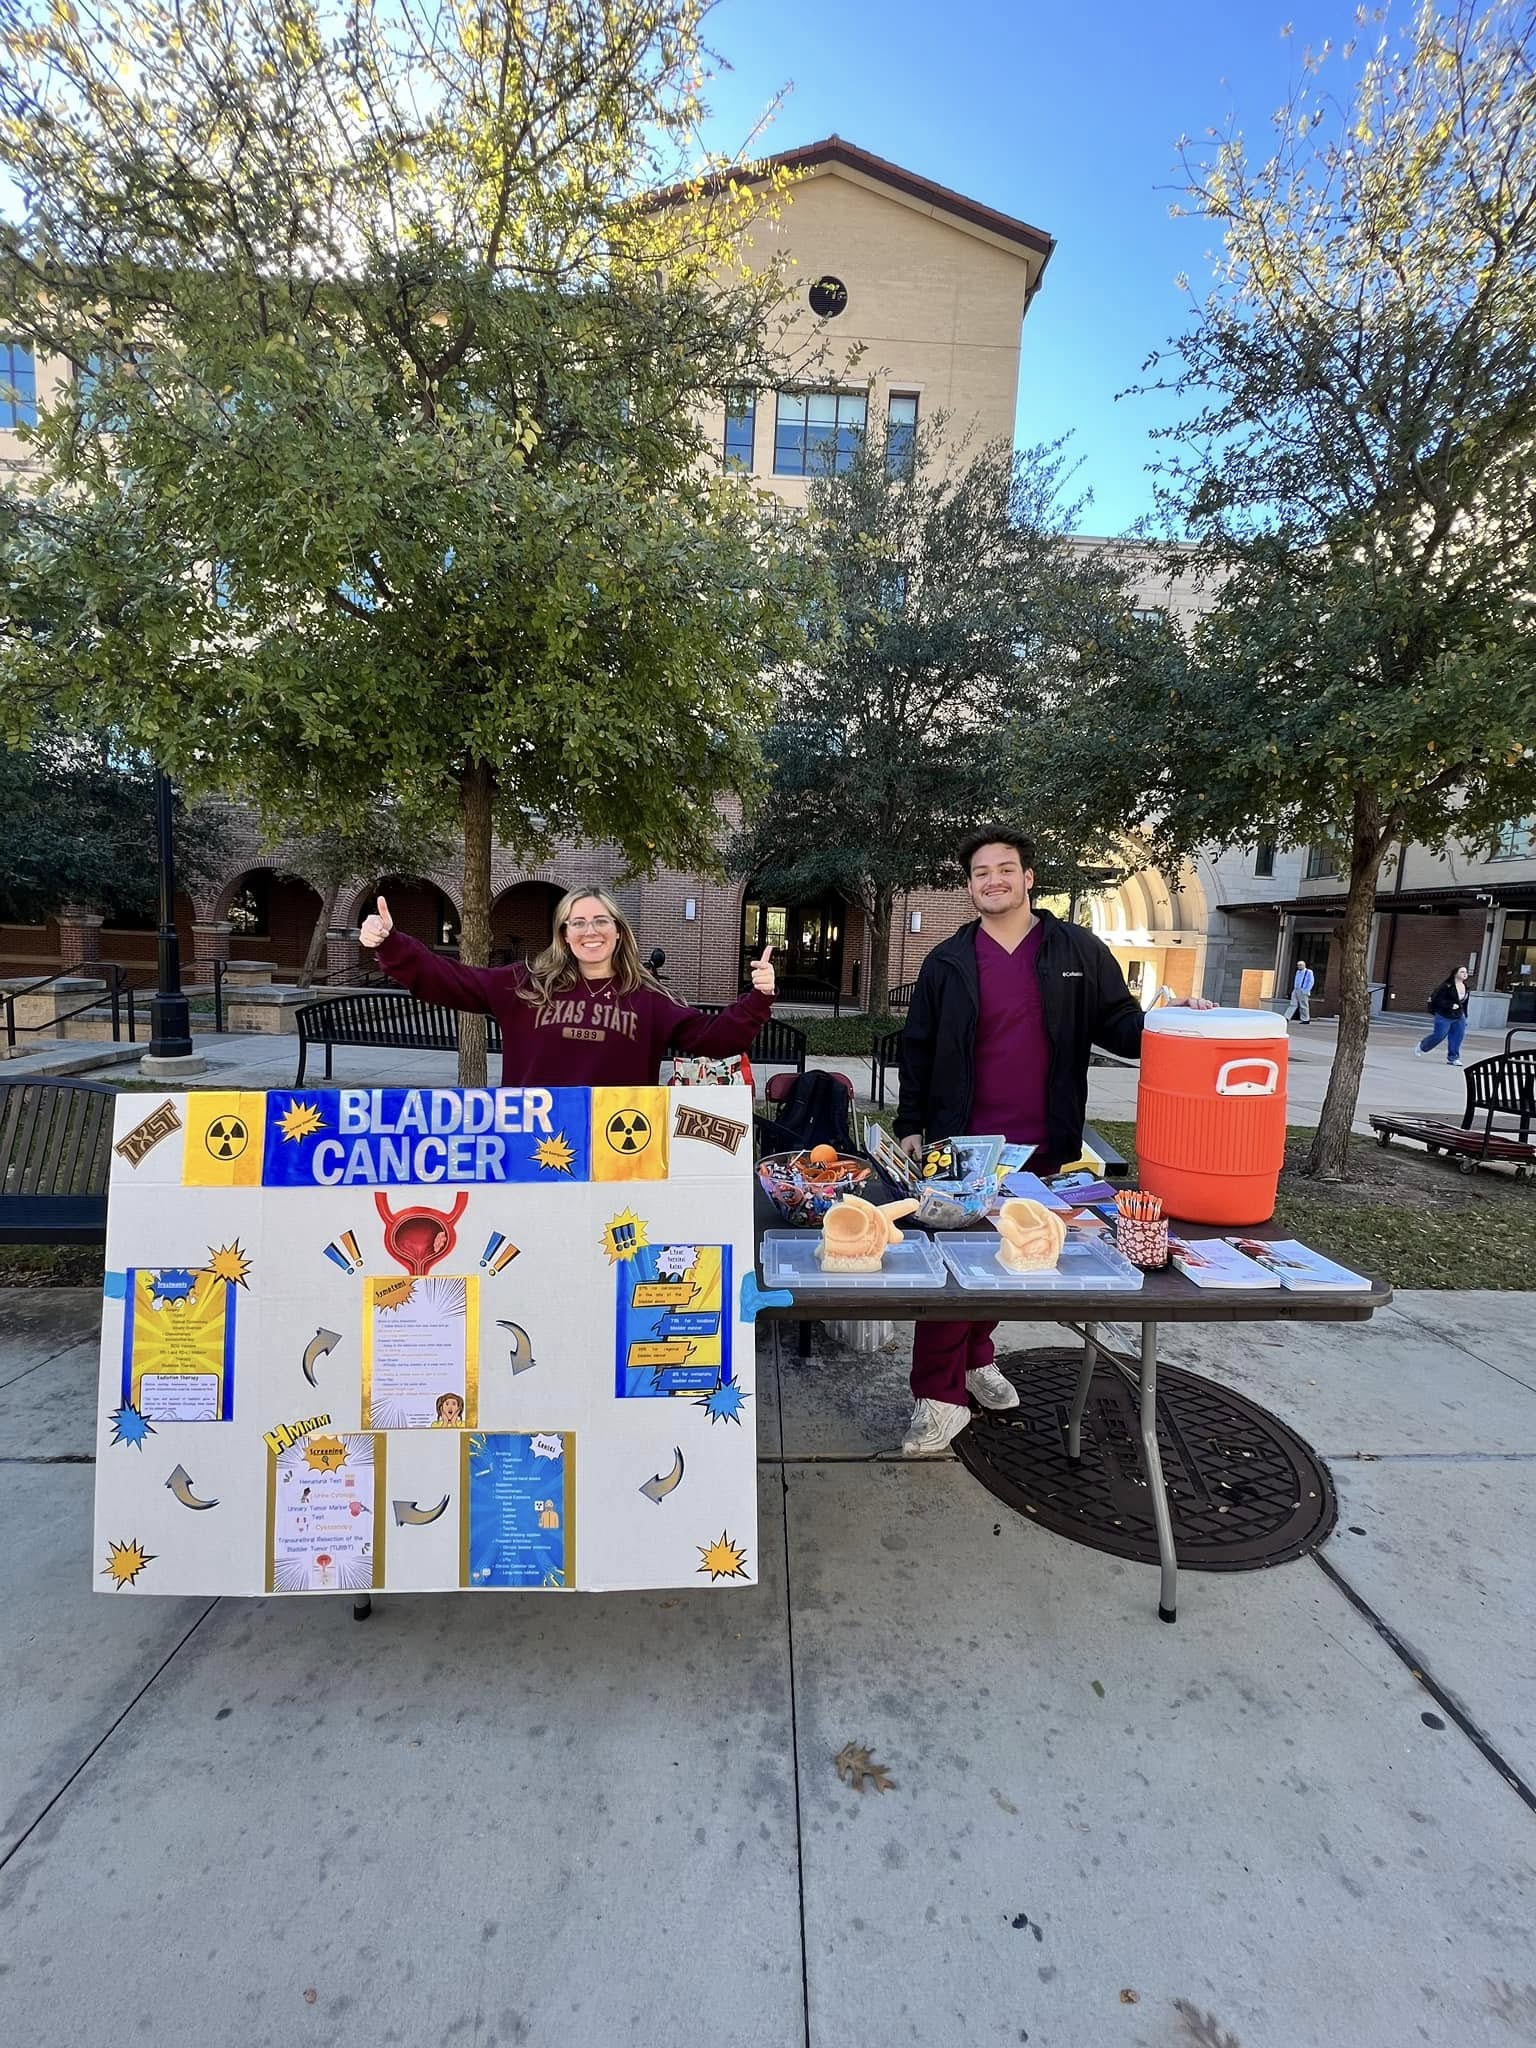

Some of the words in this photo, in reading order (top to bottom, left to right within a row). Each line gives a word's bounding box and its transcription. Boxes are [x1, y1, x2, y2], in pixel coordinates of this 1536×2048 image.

[534, 1000, 586, 1029] TEXAS
[592, 1002, 638, 1041] STATE
[570, 1029, 598, 1040] 1899
[116, 1101, 181, 1164] TXST
[339, 1088, 554, 1135] BLADDER
[677, 1106, 746, 1152] TXST
[312, 1135, 506, 1186] CANCER
[376, 1280, 406, 1298] Symptoms
